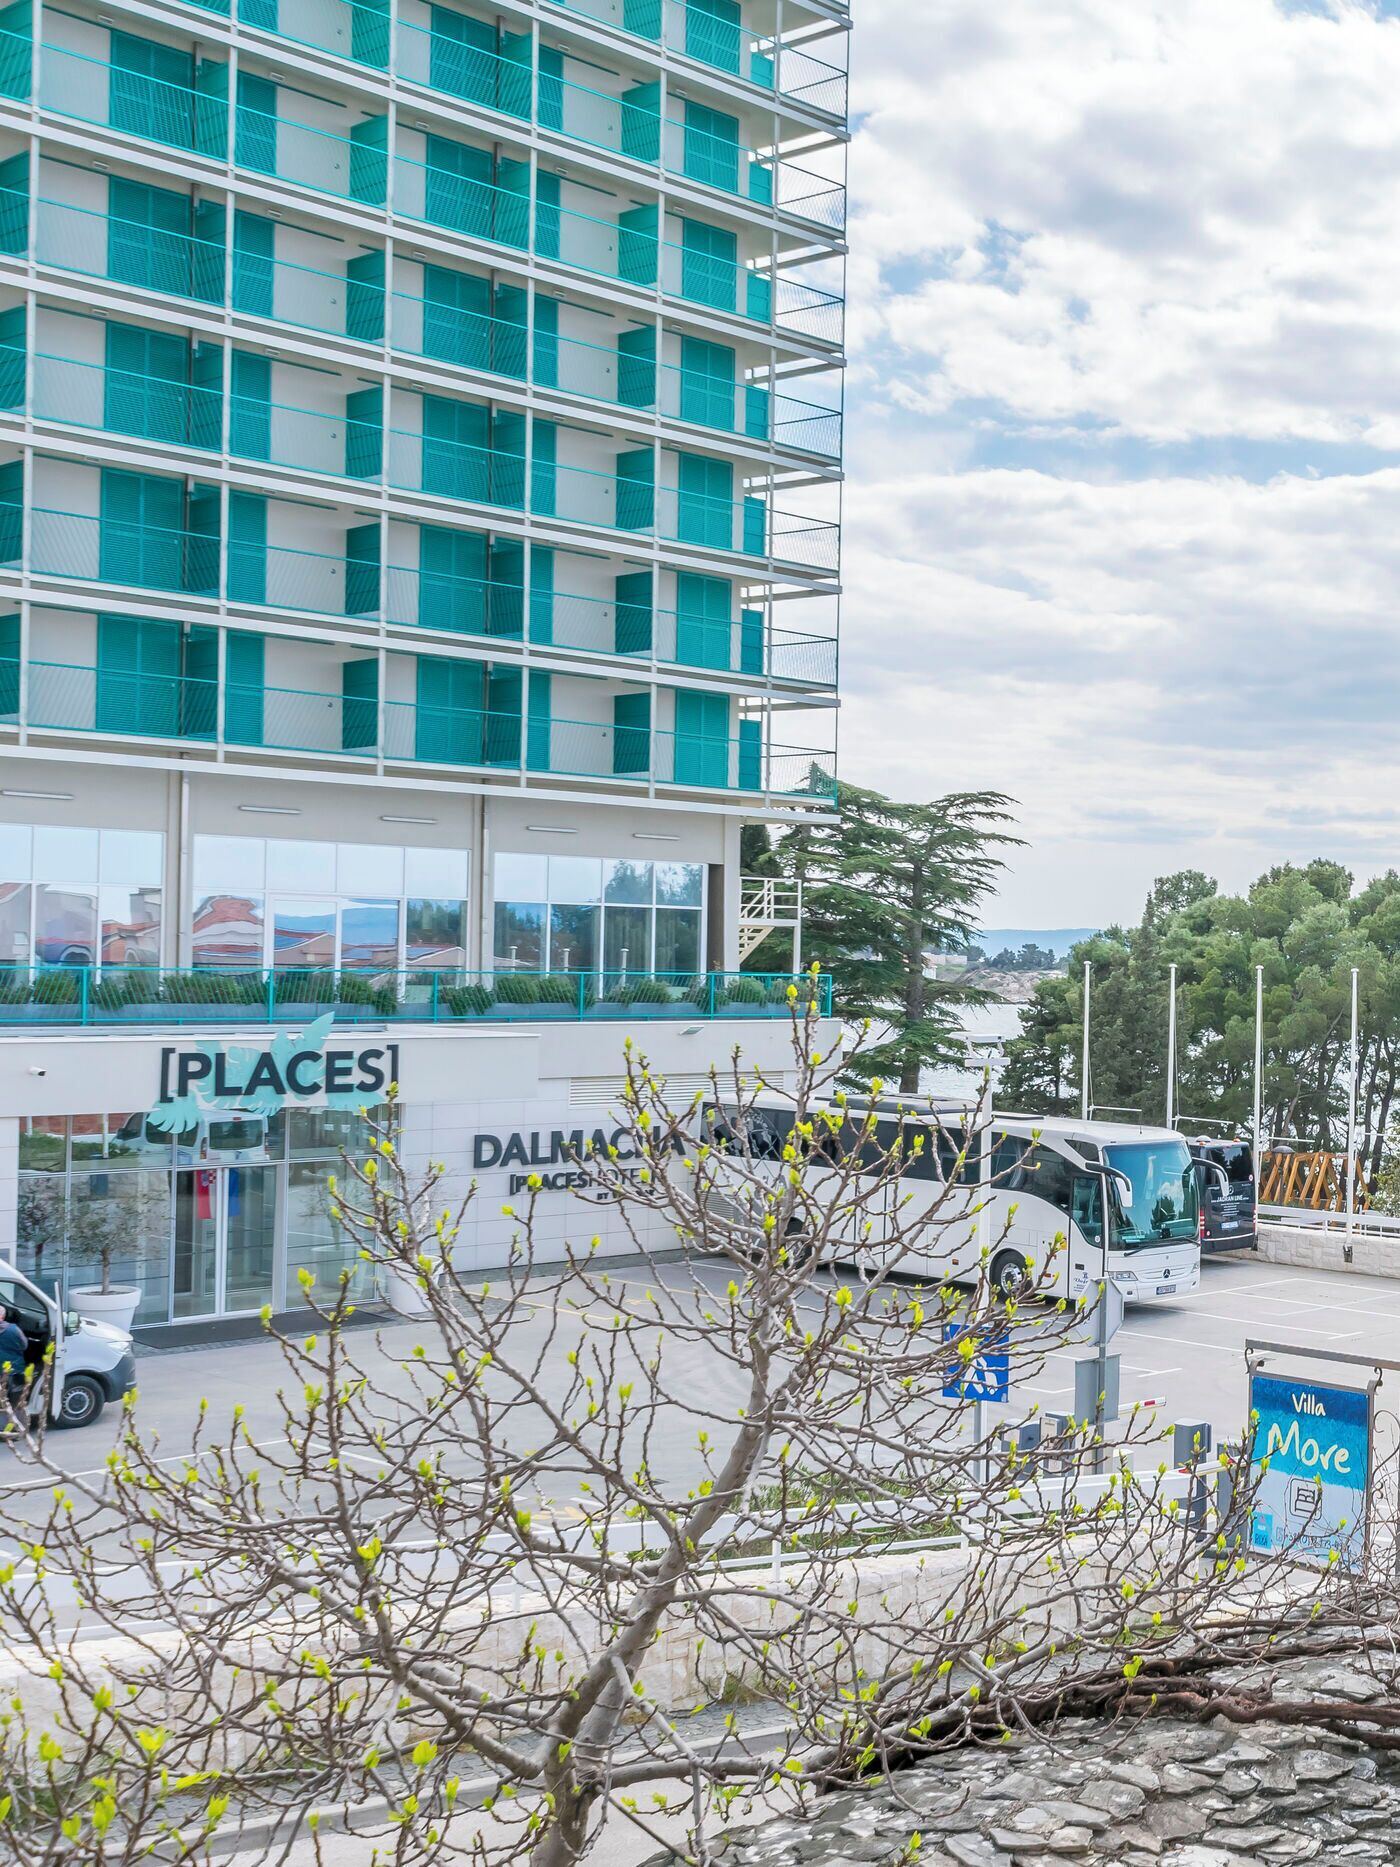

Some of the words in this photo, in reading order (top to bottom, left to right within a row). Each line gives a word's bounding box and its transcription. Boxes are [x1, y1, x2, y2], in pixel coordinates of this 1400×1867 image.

[159, 1044, 399, 1104] [PLACES]
[1292, 1392, 1326, 1416] Villa
[1266, 1420, 1351, 1474] More
